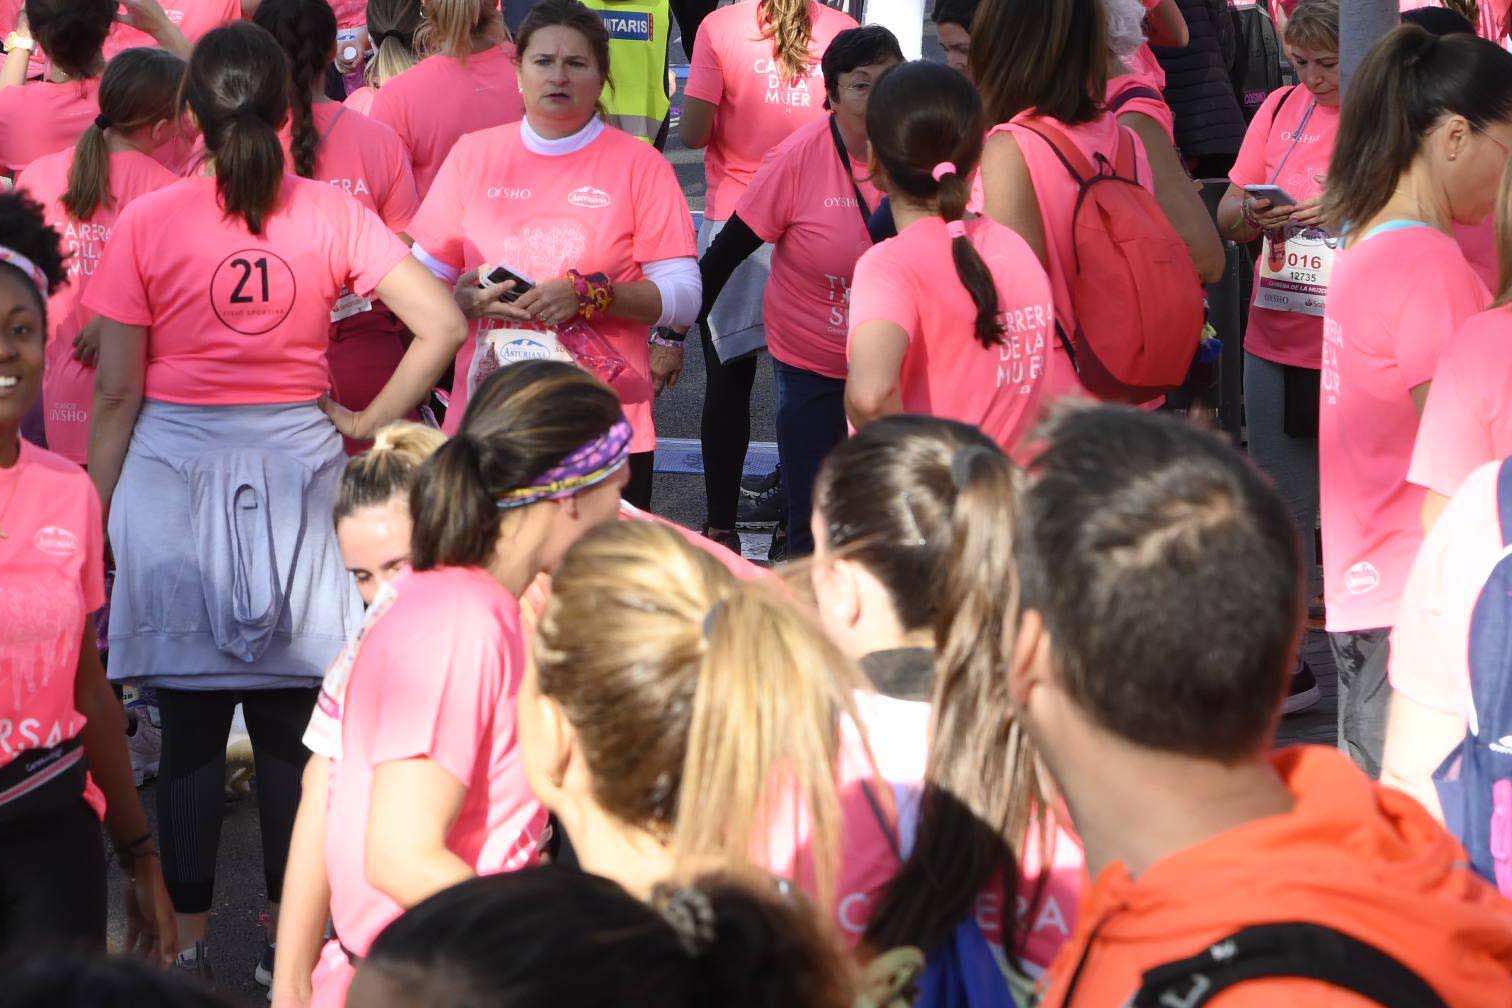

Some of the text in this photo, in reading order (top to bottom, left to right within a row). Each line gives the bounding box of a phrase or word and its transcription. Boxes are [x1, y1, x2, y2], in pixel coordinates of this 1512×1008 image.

[1287, 252, 1322, 270] 016
[229, 256, 270, 304] 21
[1289, 271, 1317, 283] 12735
[503, 345, 548, 360] ASTURIANA
